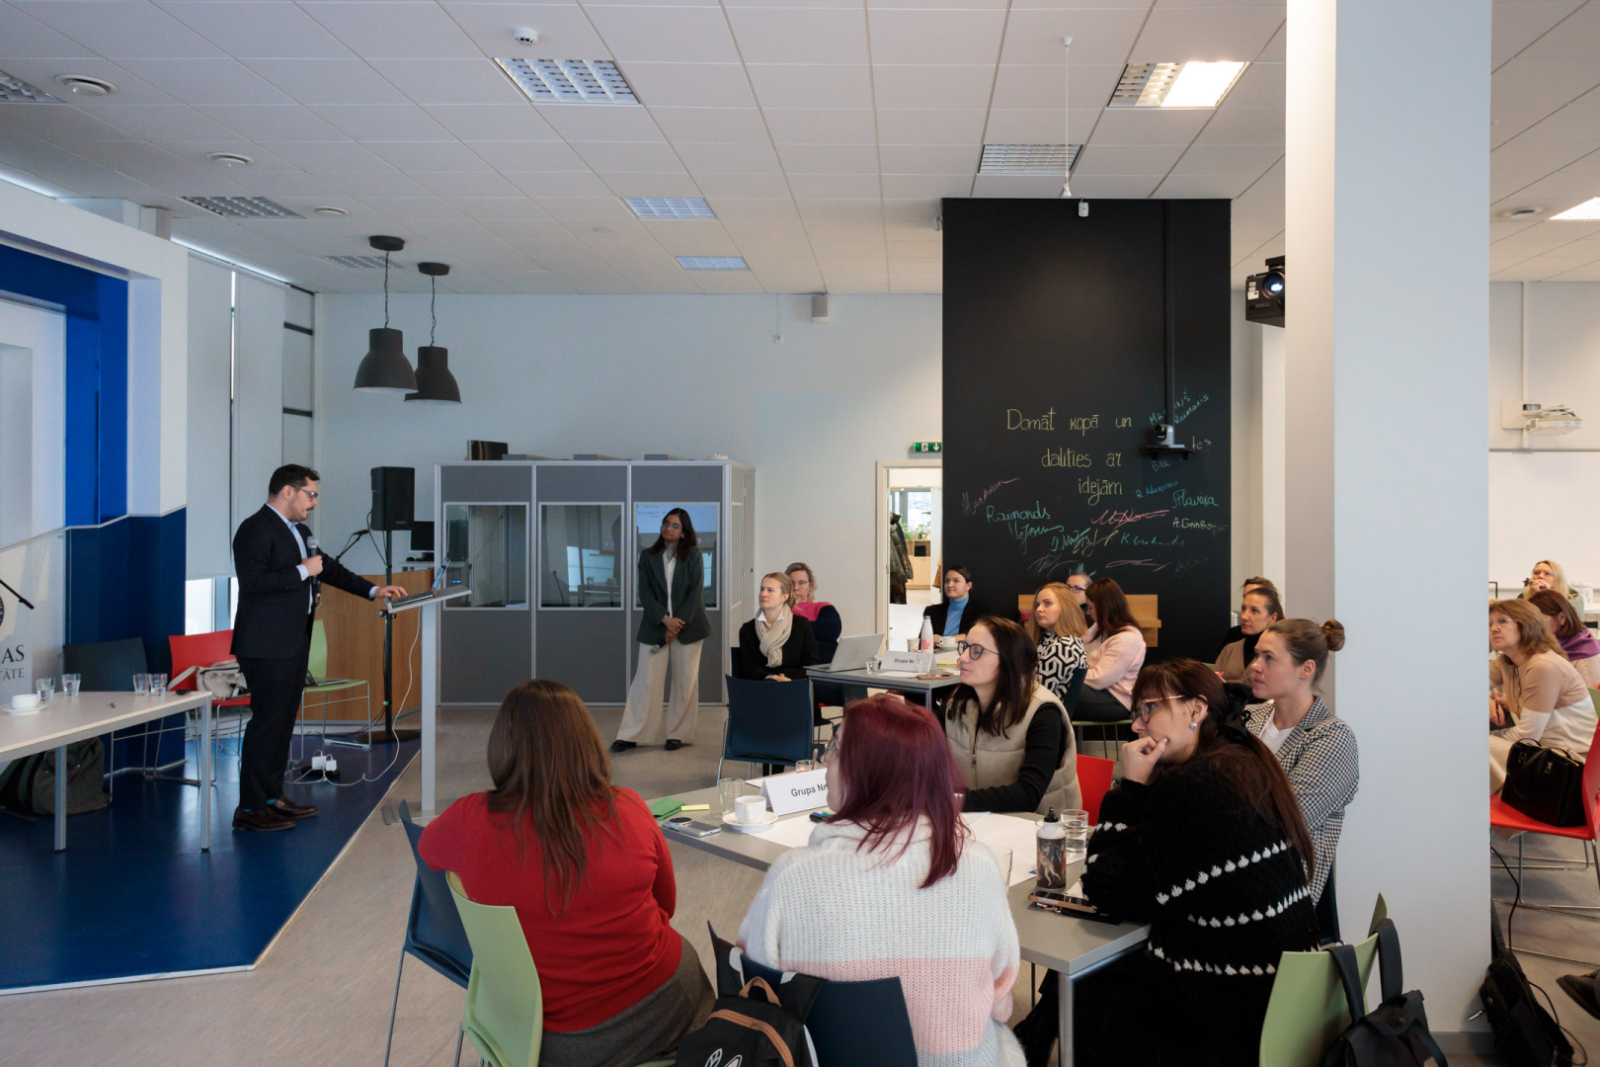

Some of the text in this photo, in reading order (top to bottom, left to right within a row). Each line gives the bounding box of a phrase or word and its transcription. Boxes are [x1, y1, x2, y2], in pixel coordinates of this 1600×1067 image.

[1006, 407, 1132, 436] Domāt kopā un
[1106, 453, 1121, 467] ar
[1078, 476, 1123, 506] idejām
[986, 501, 1050, 522] Raimonds
[0, 667, 24, 682] ĀTE
[791, 786, 816, 797] Grupa
